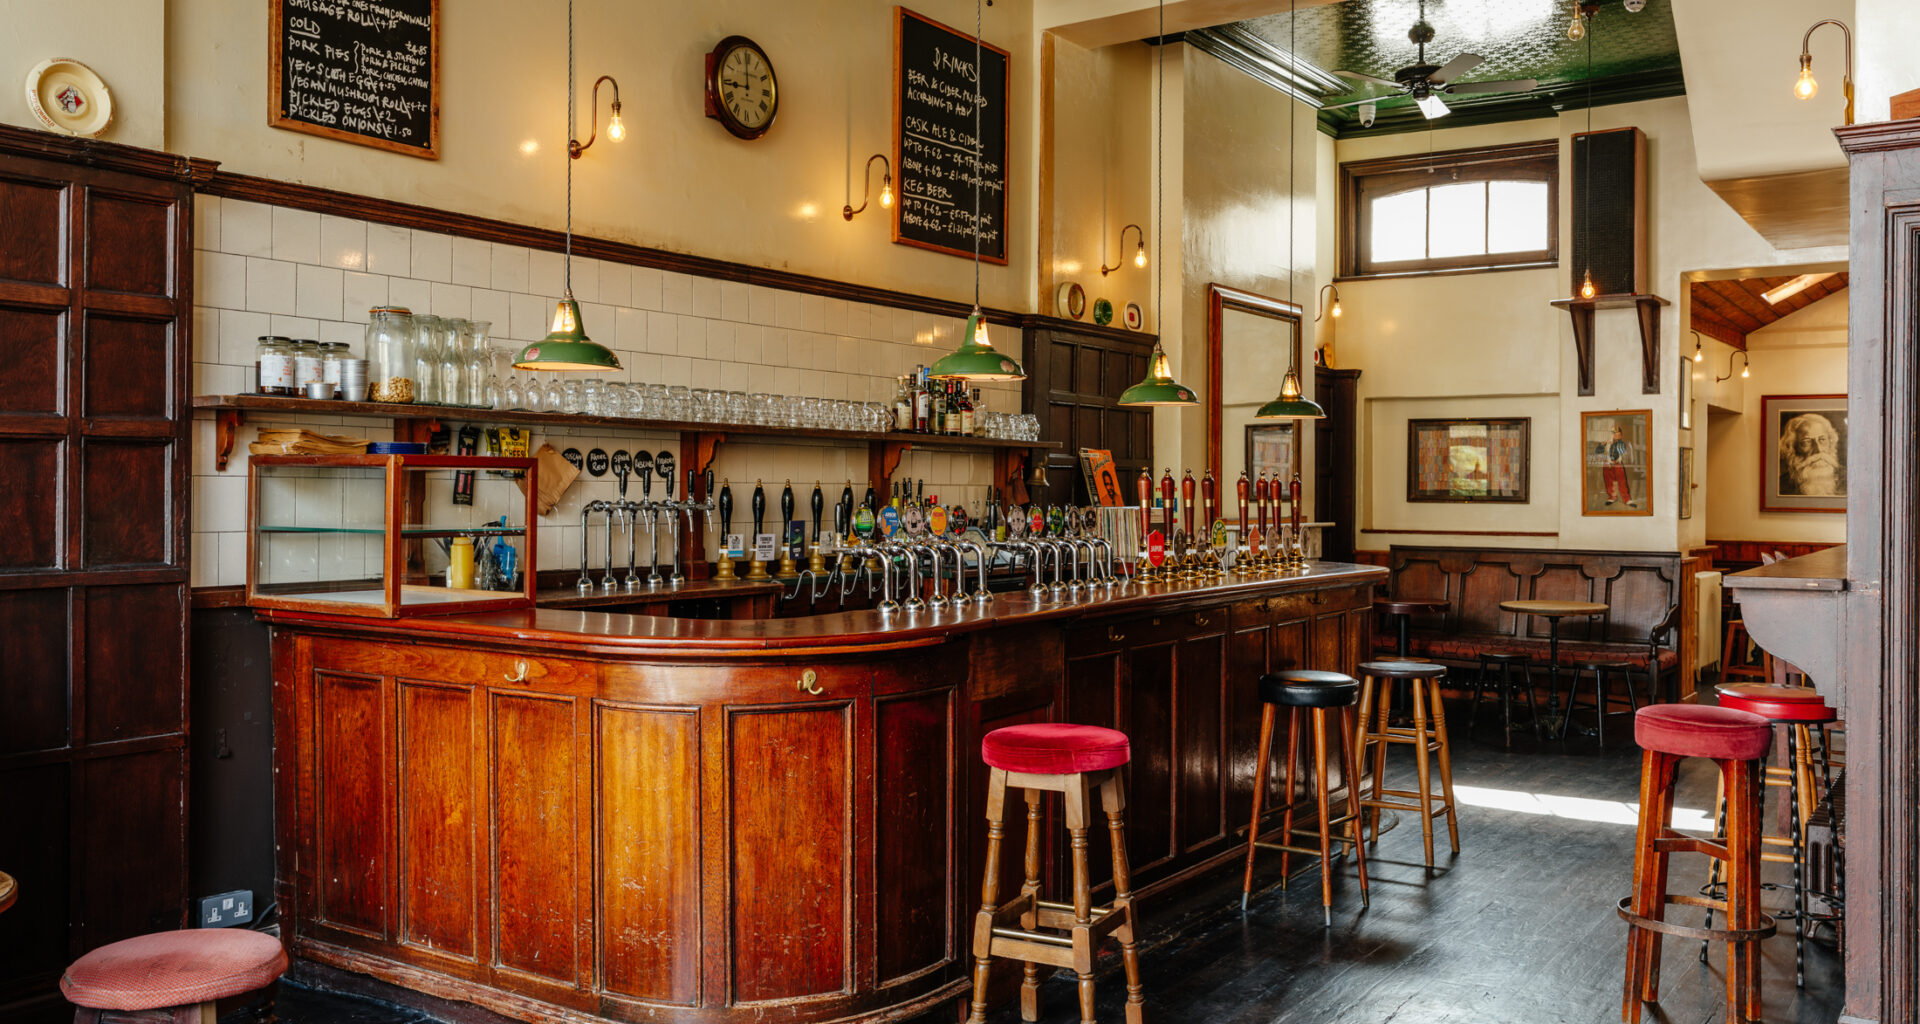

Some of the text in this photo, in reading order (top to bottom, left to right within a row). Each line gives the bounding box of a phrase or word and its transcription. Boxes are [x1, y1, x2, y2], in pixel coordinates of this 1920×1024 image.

[290, 16, 320, 34] COLD
[347, 9, 375, 27] ROLL
[390, 9, 431, 31] CORNWALL!
[288, 35, 350, 61] PORK PIES
[360, 43, 384, 58] PORK
[386, 50, 393, 60] &
[288, 56, 316, 74] VEG
[348, 72, 372, 90] EGG
[361, 54, 382, 68] PORK
[390, 60, 417, 74] PICKLE
[933, 47, 977, 82] DRINKS
[289, 73, 326, 92] VEGAN
[328, 82, 380, 106] MUSHROOM
[382, 96, 408, 114] ROLL
[908, 68, 930, 88] BEER
[940, 81, 962, 99] CIDER
[289, 89, 396, 122] PICKLED EGGS £2
[907, 86, 973, 118] ACCORDING TO ABV
[289, 104, 412, 138] PICKLED ONIONS £1.50
[905, 116, 930, 134] CASK
[932, 122, 948, 138] ALE
[950, 128, 958, 142] &
[904, 137, 913, 151] UP
[913, 142, 922, 154] TO
[902, 156, 922, 174] ABOVE
[903, 177, 953, 198] KEG BEER
[902, 198, 912, 210] UP
[914, 200, 922, 211] TO
[902, 210, 922, 226] ABOVE
[592, 461, 607, 472] Red
